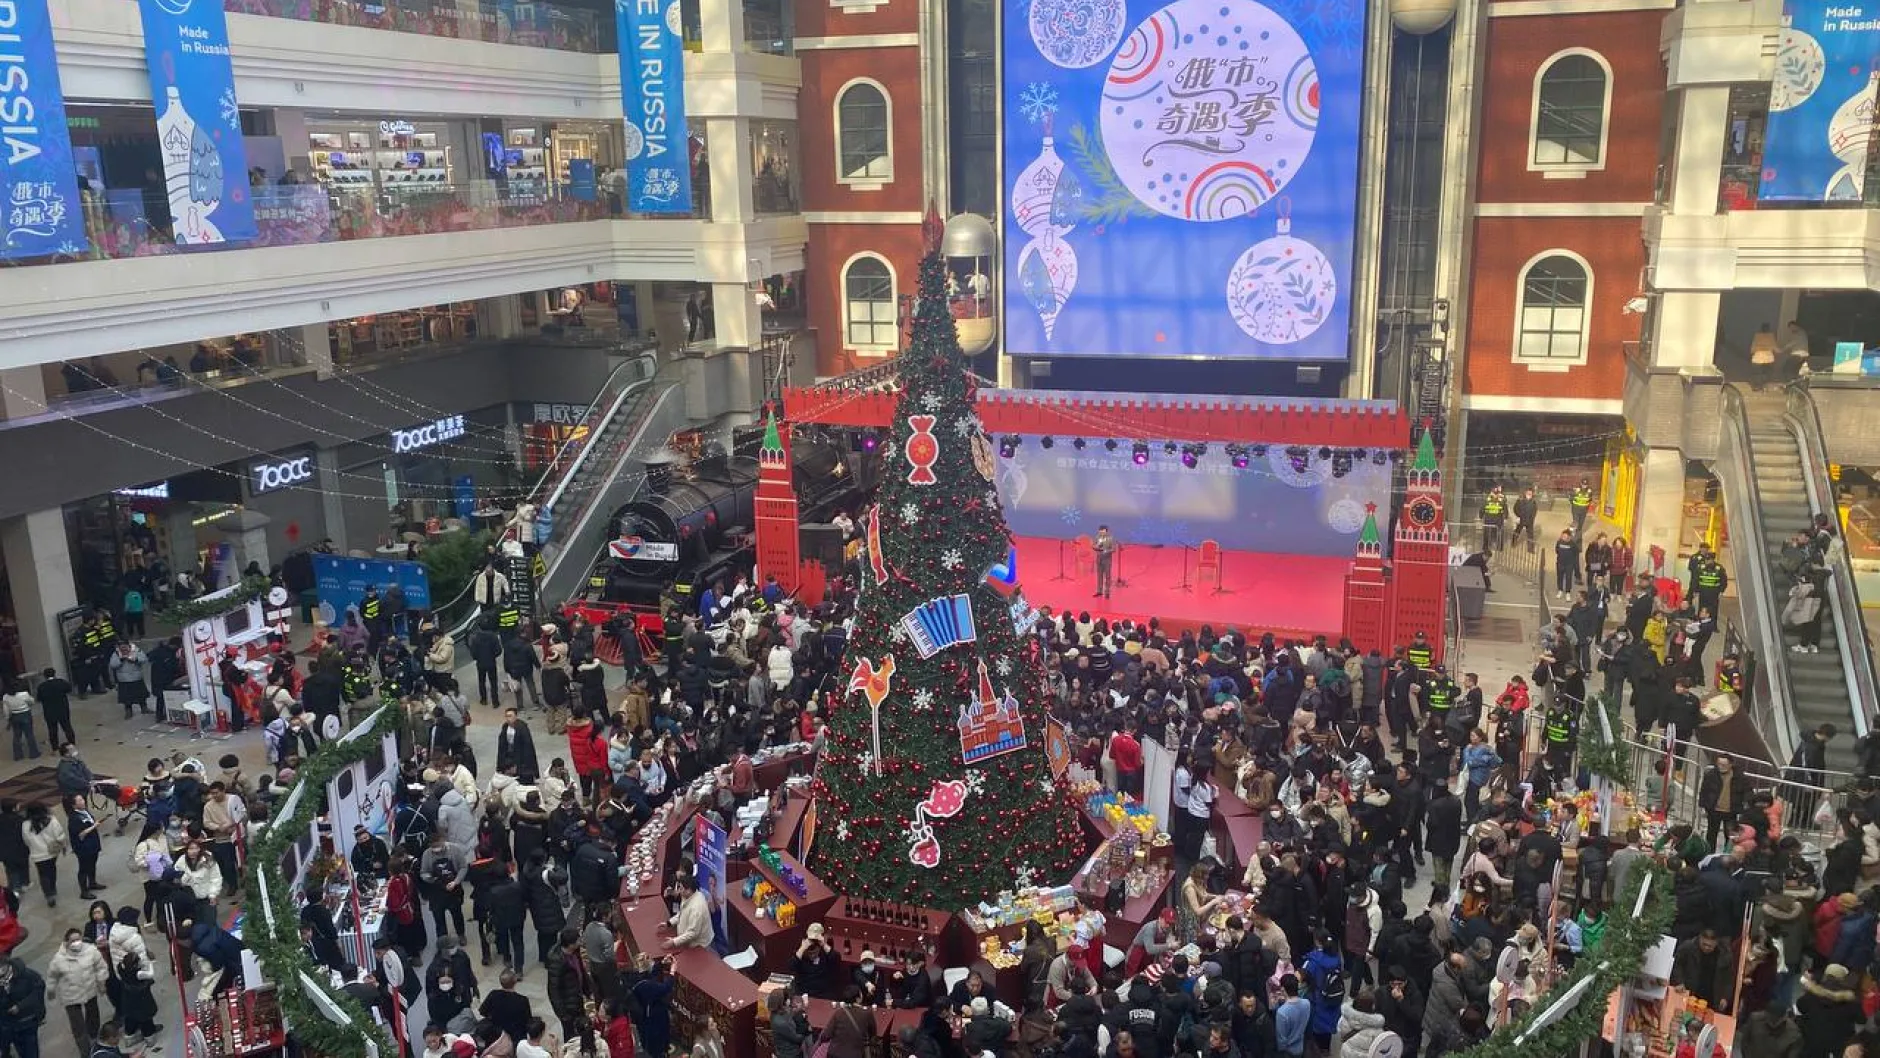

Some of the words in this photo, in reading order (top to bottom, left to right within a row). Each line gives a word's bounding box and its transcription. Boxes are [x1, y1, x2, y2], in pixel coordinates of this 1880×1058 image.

[1826, 6, 1862, 18] Made
[178, 25, 208, 39] Made
[1823, 20, 1837, 32] in
[639, 25, 662, 50] IN
[181, 41, 192, 53] in
[193, 41, 230, 55] Russia
[641, 59, 667, 158] RUSSIA
[1156, 91, 1282, 137] 奇遇季
[391, 424, 437, 453] 700CC
[254, 456, 311, 491] 700CC
[1128, 1008, 1155, 1021] FUSION
